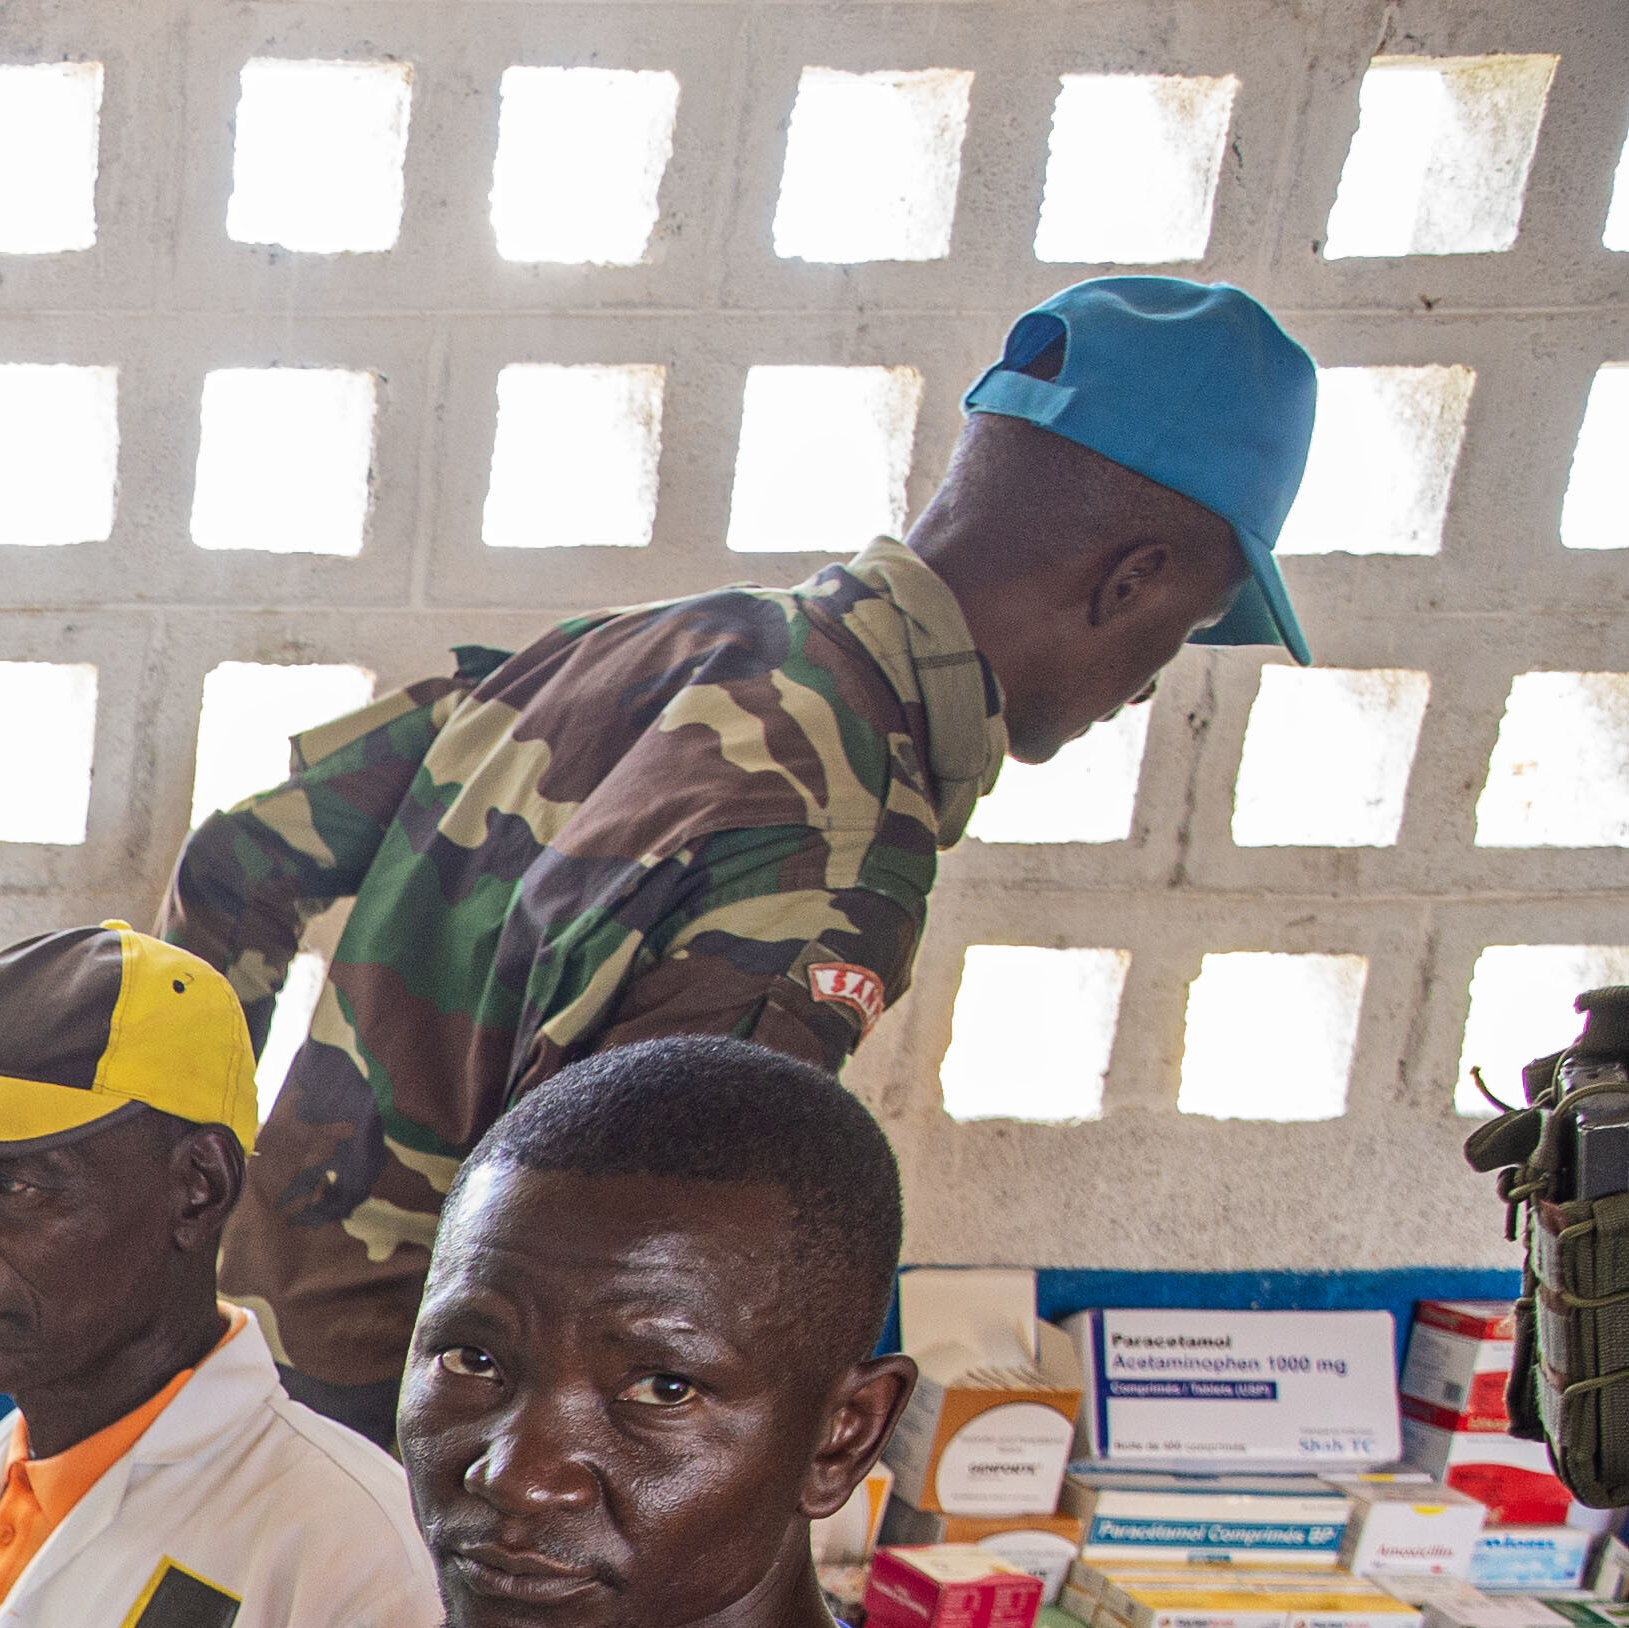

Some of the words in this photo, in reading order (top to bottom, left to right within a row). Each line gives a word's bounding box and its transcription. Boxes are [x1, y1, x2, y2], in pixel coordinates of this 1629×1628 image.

[1111, 1333, 1232, 1349] Paracetamol
[1112, 1354, 1260, 1372] Acetaminophen
[1268, 1356, 1310, 1371] 1000
[1316, 1359, 1347, 1376] mg
[1308, 1524, 1336, 1544] BP
